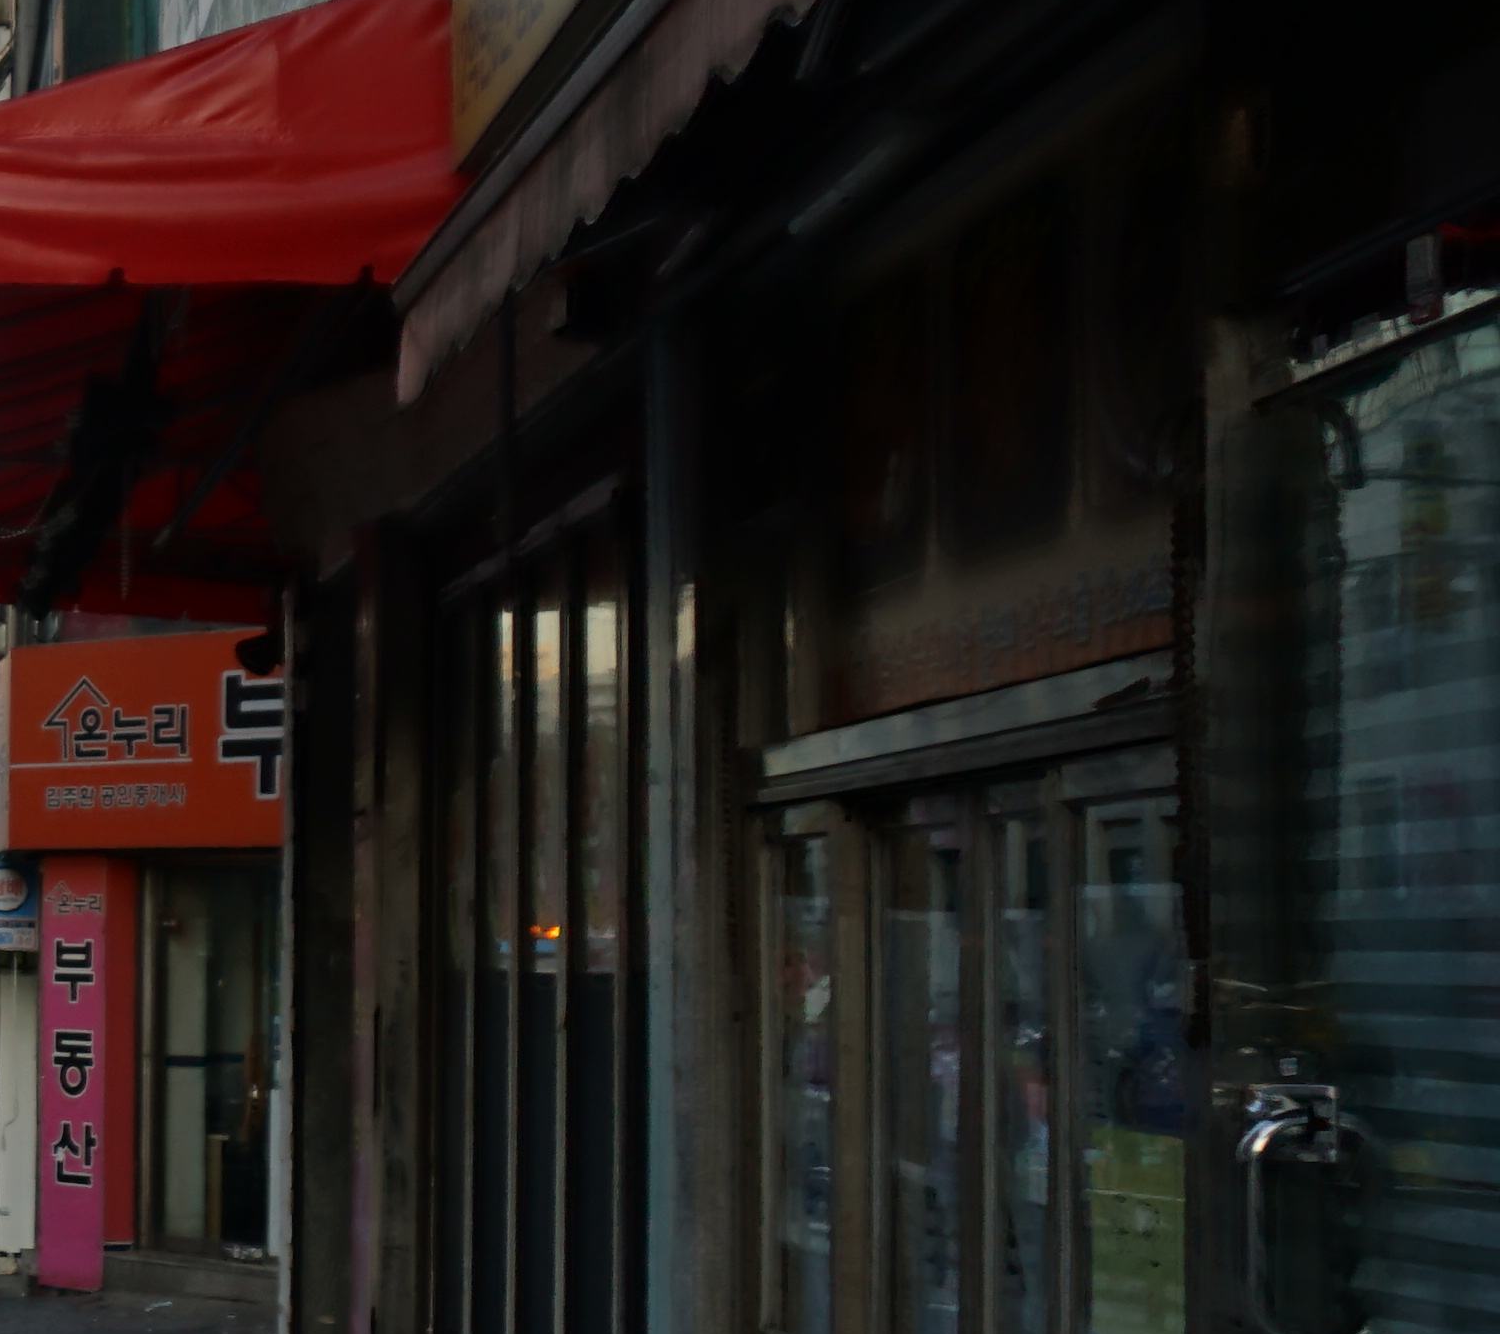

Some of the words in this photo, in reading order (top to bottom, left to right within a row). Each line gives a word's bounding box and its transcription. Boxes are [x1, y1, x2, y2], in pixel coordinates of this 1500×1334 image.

[74, 704, 189, 759] 온누리
[46, 787, 95, 809] 김주환
[101, 783, 187, 808] 공인중개사
[58, 892, 101, 913] 온누리
[51, 937, 97, 1189] 부동산
